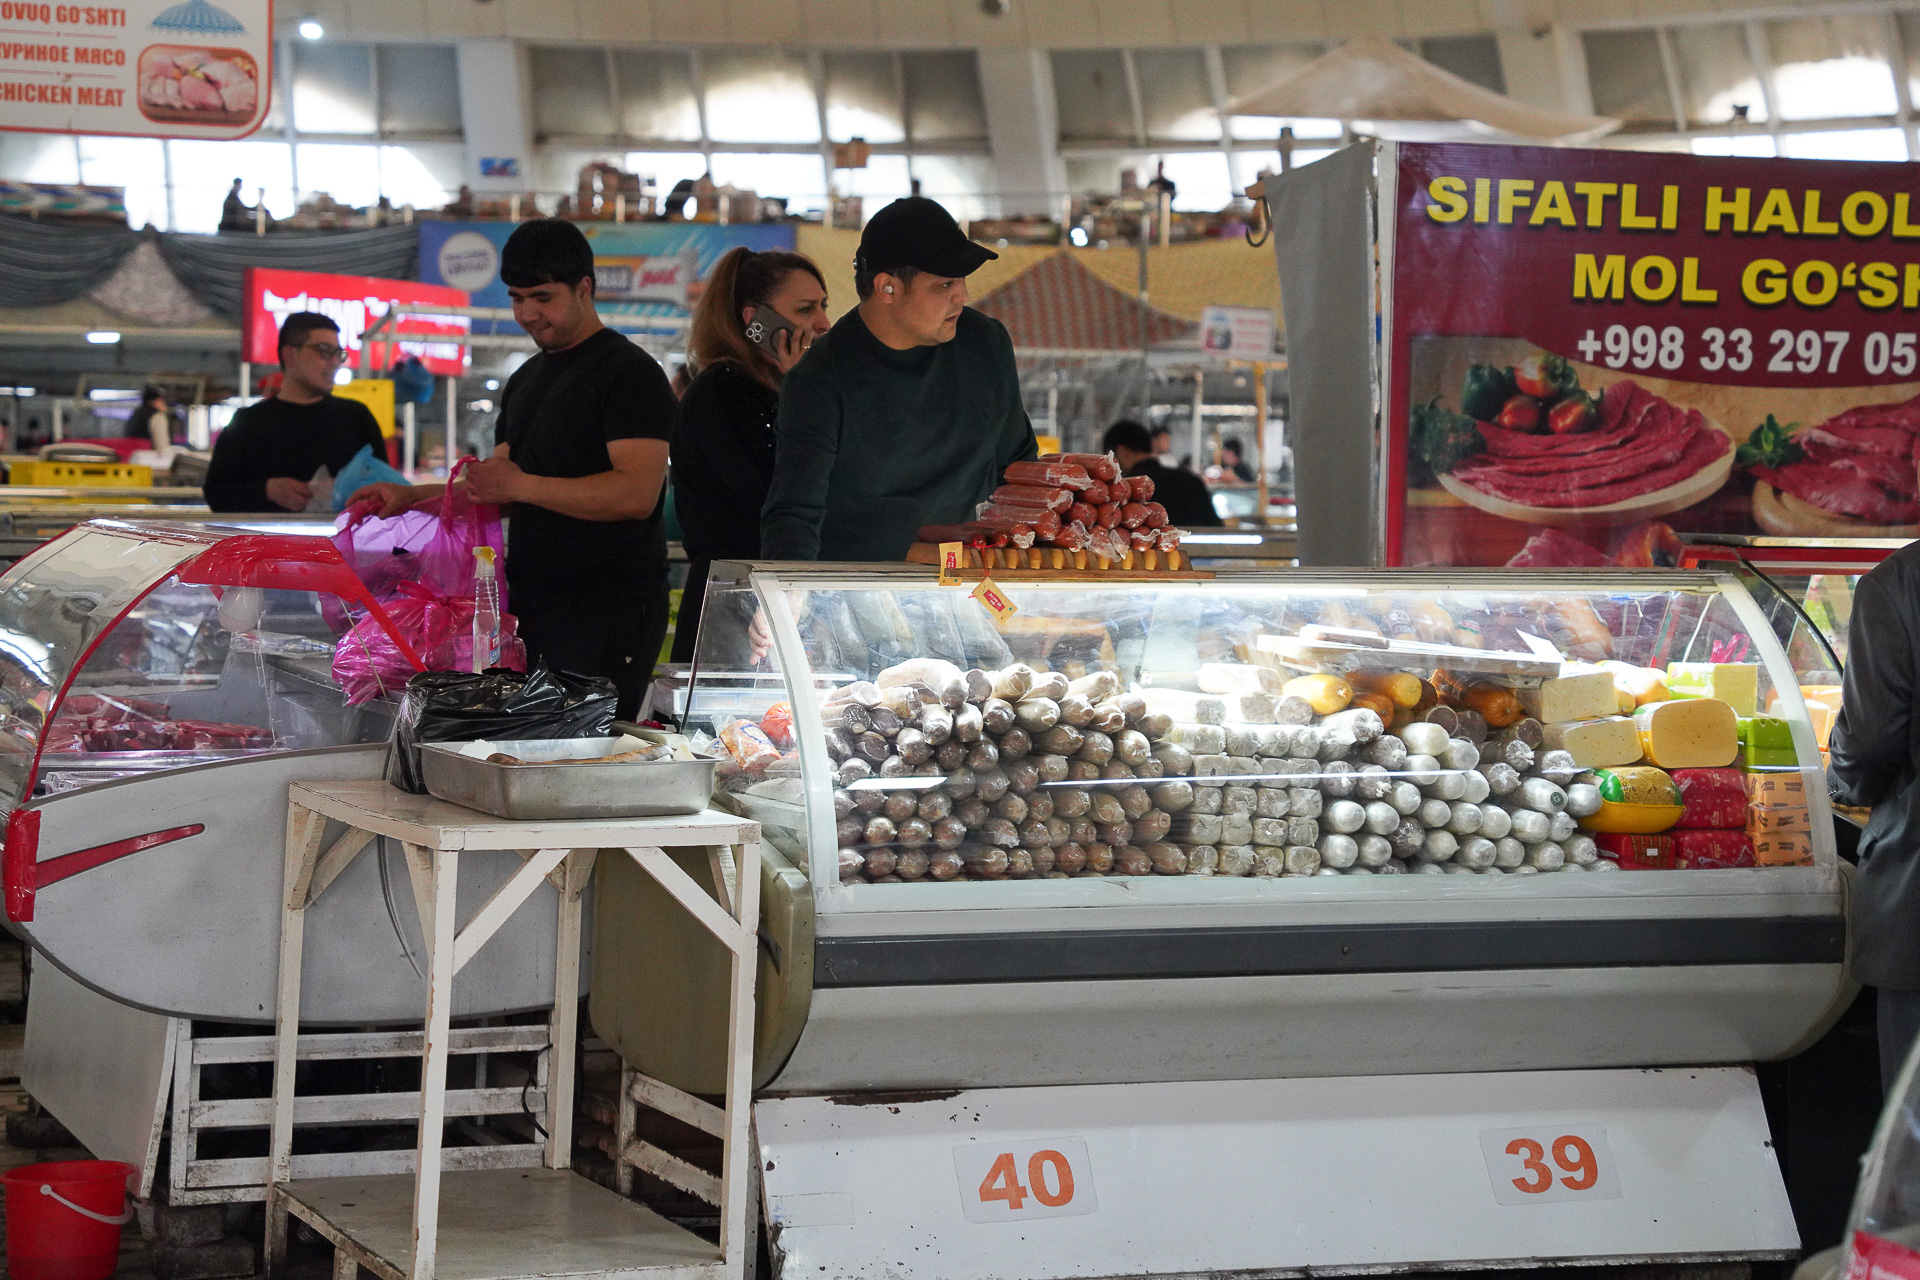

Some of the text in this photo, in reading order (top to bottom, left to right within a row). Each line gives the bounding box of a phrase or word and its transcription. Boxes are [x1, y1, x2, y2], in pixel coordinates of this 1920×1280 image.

[0, 1, 51, 24] OVUQ
[74, 46, 126, 66] МЯСО
[0, 82, 125, 107] HICKEN MEAT
[1427, 176, 1920, 236] SIFATLI HALOL
[1574, 254, 1717, 302] MOL
[1577, 324, 1917, 375] +998 33 297 05
[978, 1150, 1075, 1210] 40
[1506, 1135, 1598, 1194] 39
